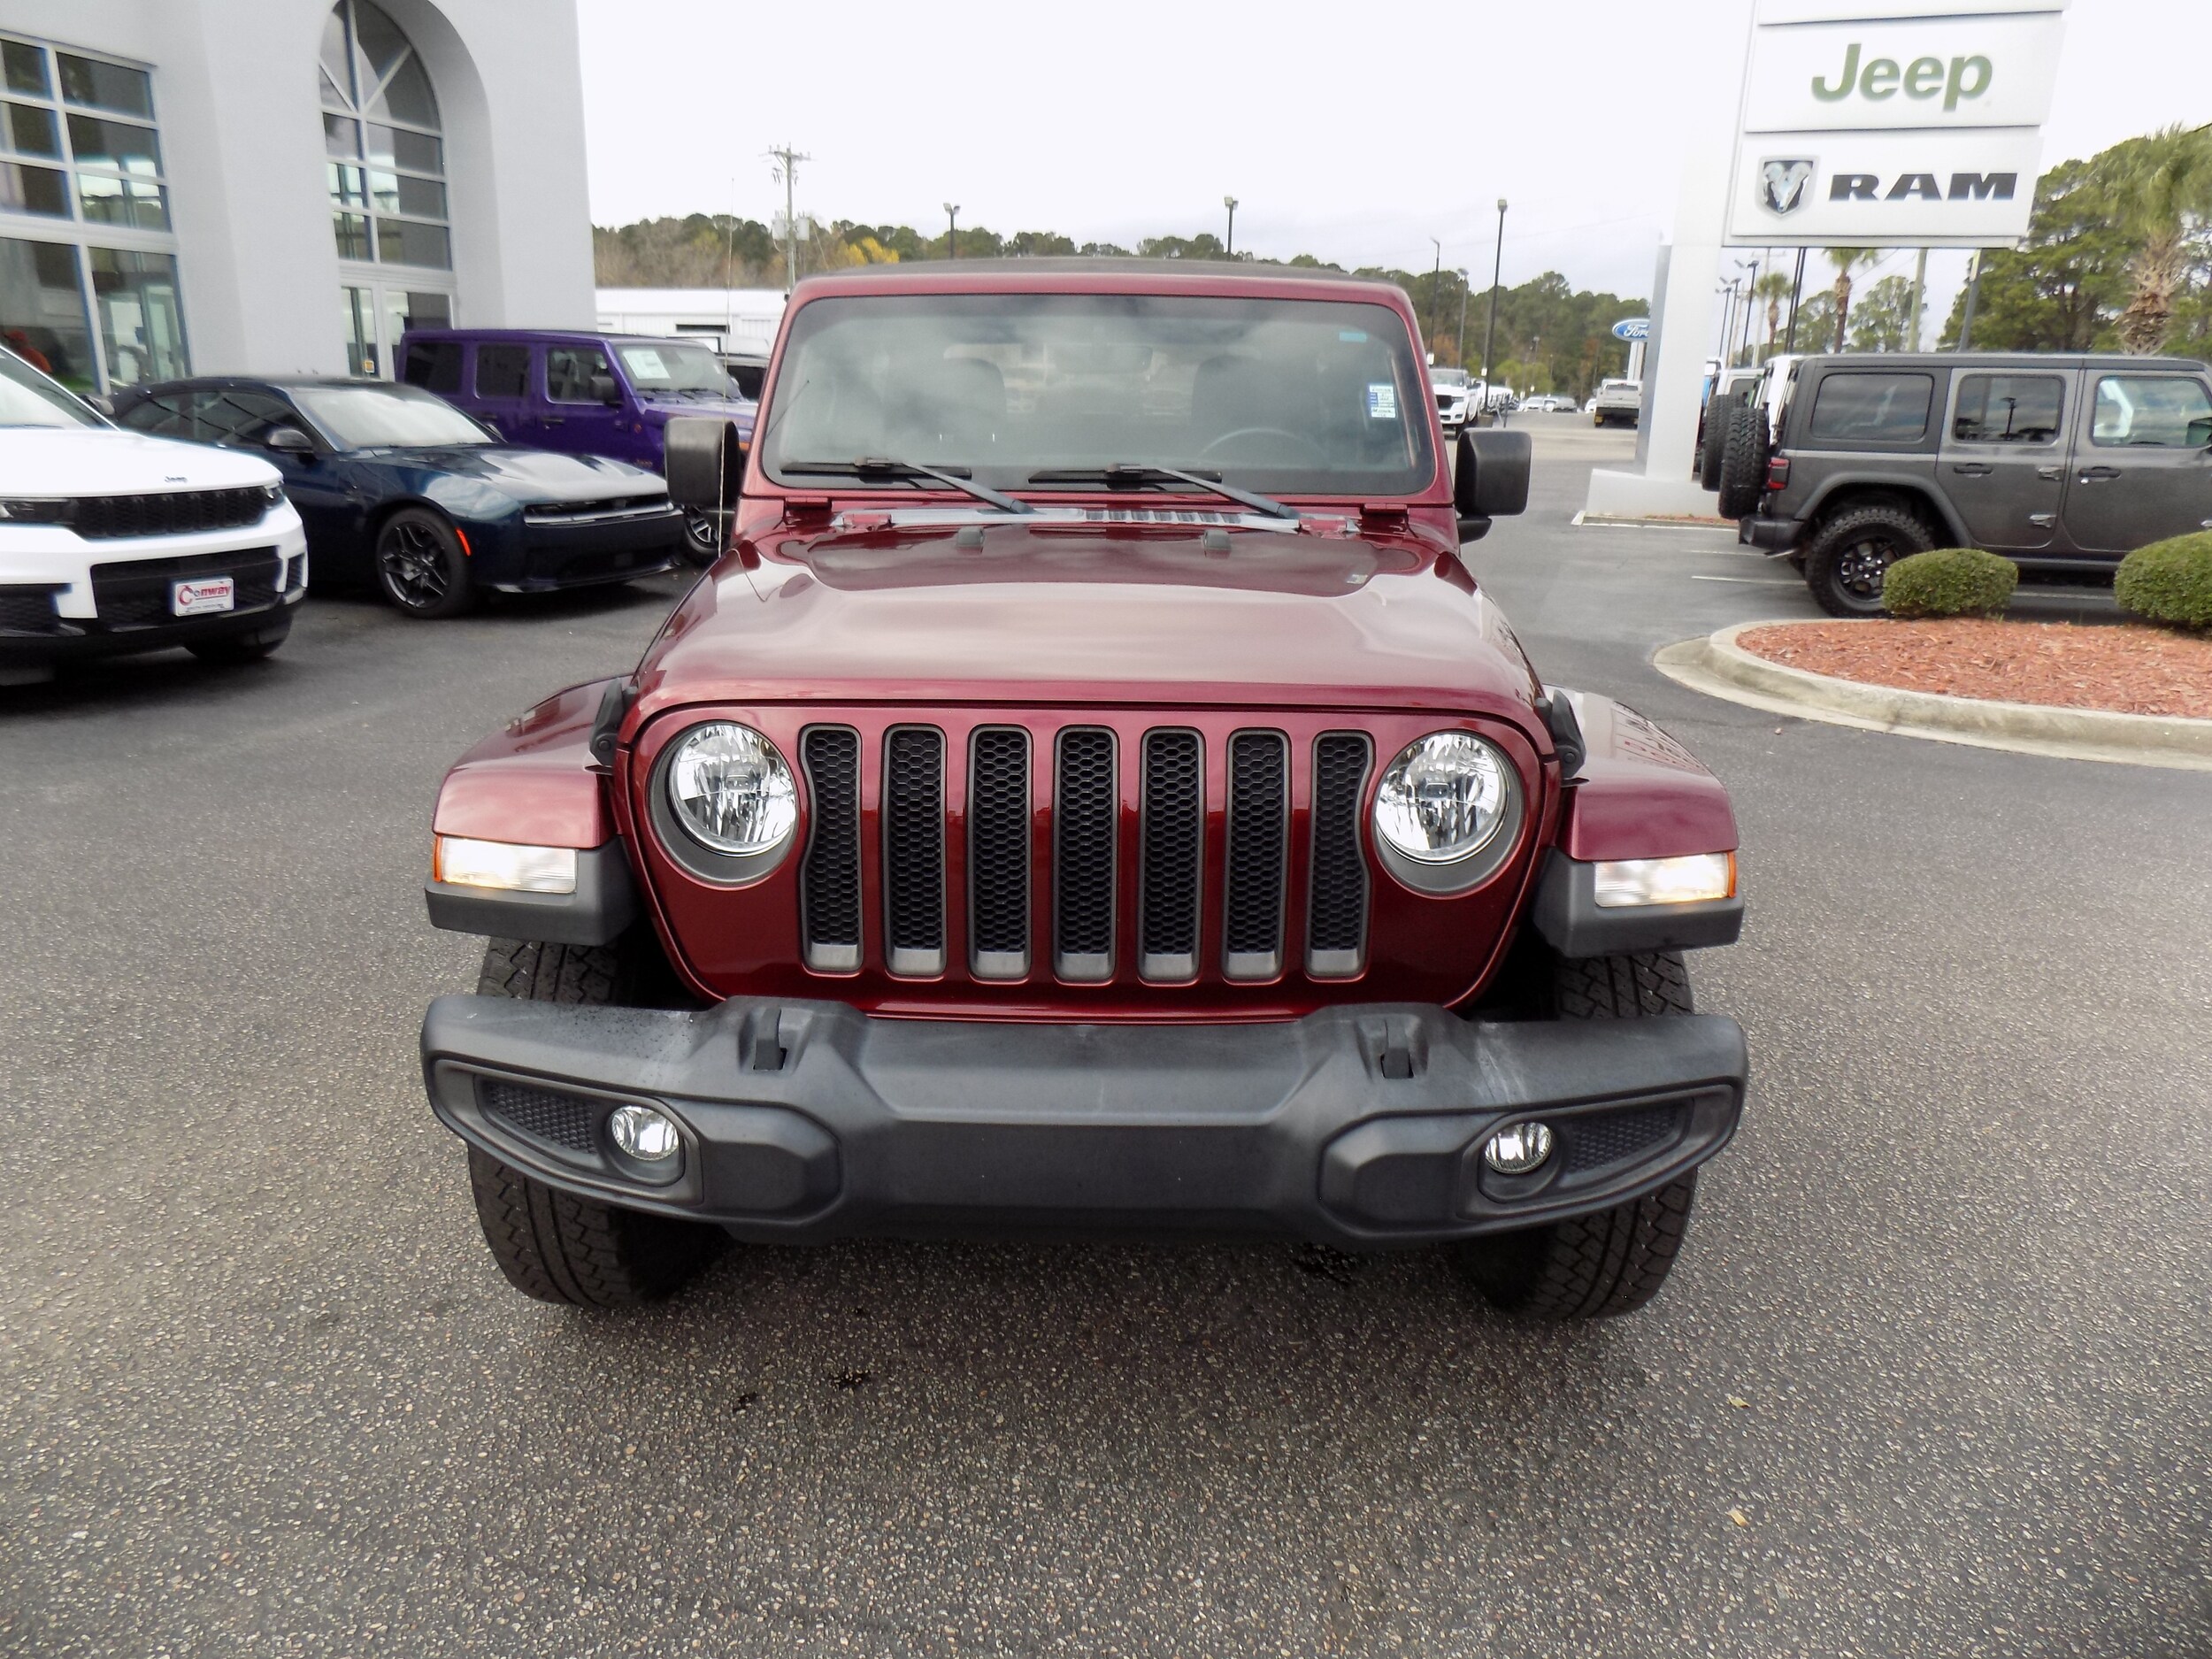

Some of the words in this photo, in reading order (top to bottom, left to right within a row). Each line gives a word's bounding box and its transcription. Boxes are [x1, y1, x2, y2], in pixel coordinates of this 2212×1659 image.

[1811, 43, 1992, 111] Jeep
[1829, 173, 2017, 201] RAM
[179, 585, 231, 606] Conway
